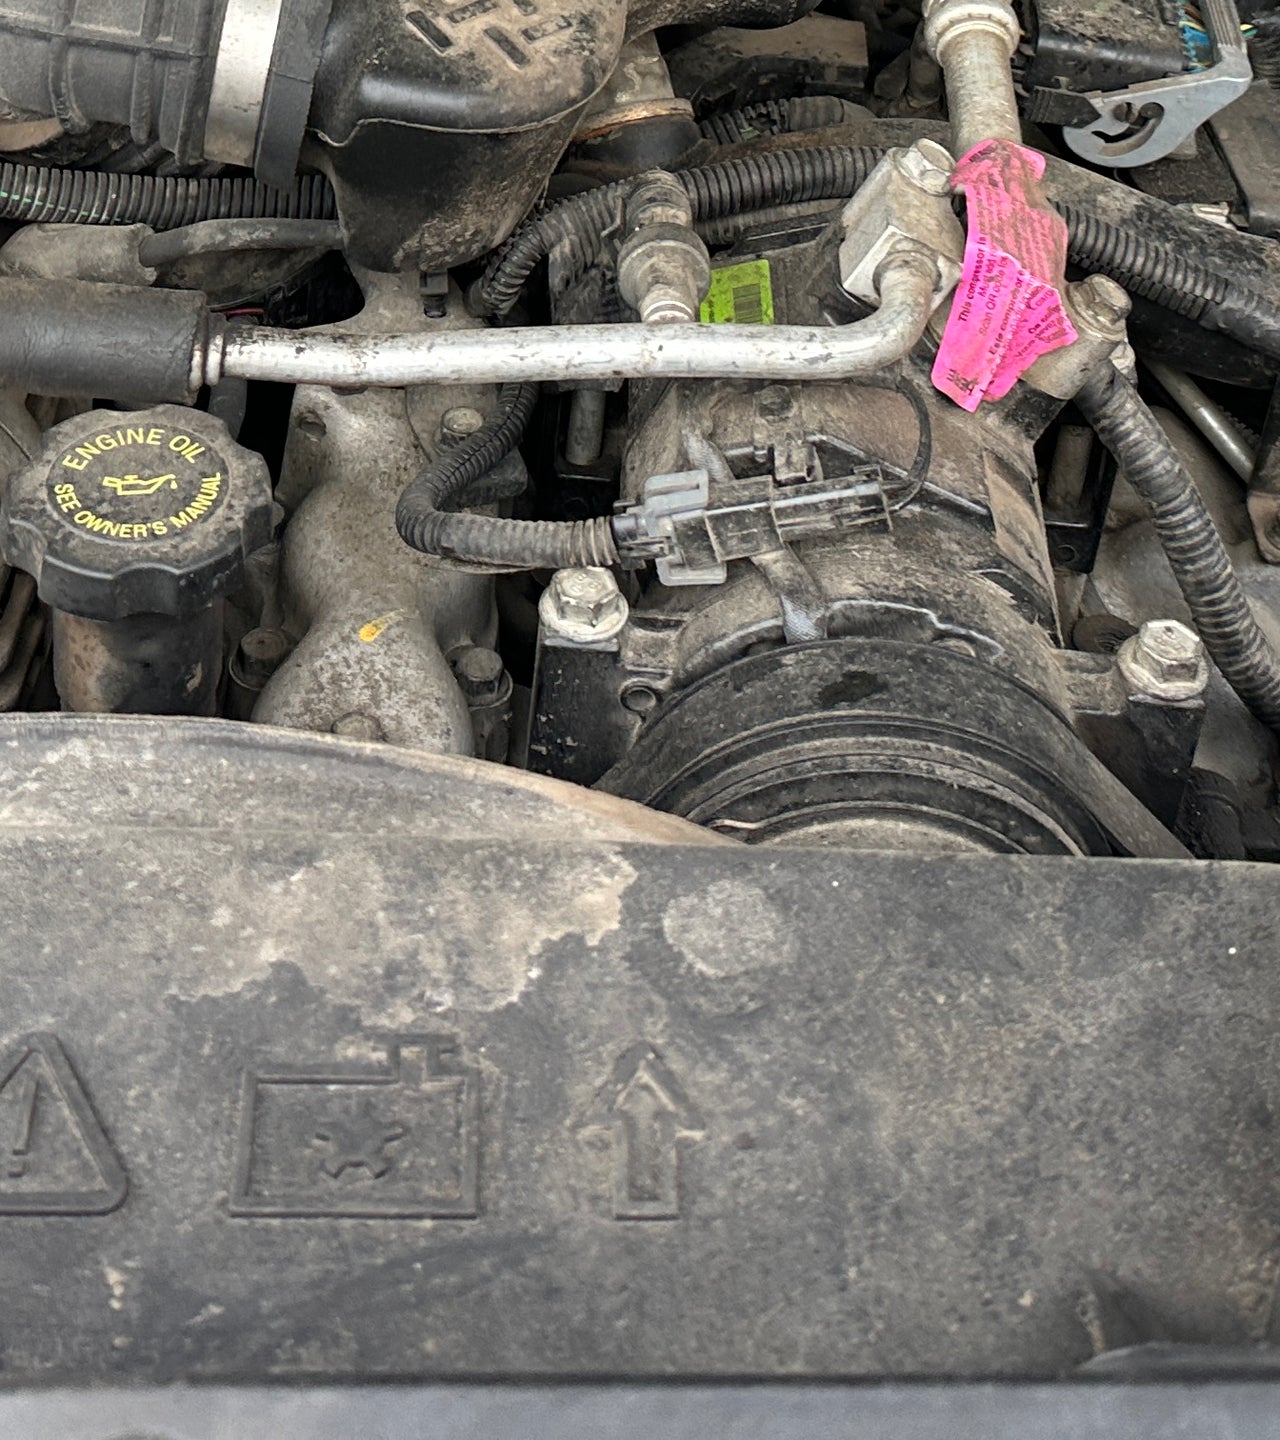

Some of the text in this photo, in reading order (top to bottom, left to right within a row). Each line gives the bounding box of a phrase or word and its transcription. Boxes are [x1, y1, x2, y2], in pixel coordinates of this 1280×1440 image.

[957, 301, 972, 322] This
[966, 247, 985, 300] compressor
[985, 292, 998, 310] QR
[979, 311, 993, 337] Scan
[62, 427, 206, 471] ENGINE OIL
[54, 471, 221, 539] SEE OWNER'S MANUAL
